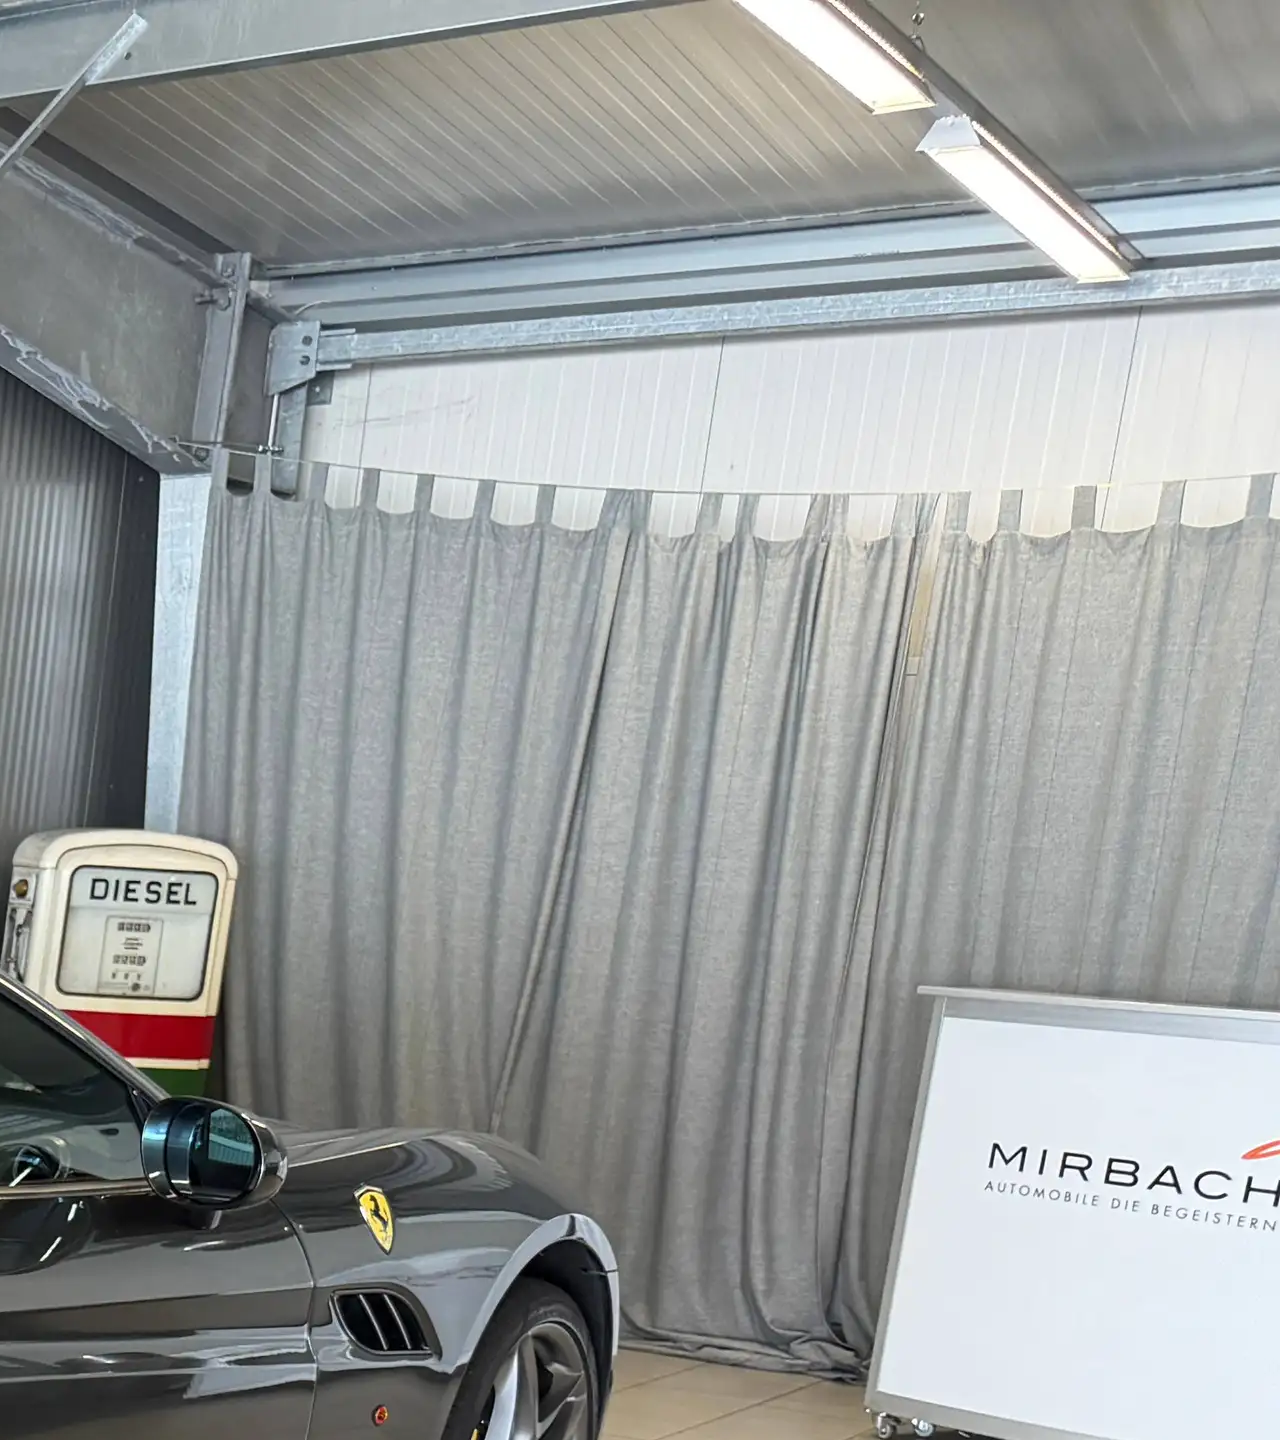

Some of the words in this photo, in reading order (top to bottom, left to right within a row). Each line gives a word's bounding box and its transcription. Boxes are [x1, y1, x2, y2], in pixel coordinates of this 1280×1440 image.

[89, 878, 198, 906] DIESEL
[988, 1142, 1280, 1208] MIRBACH
[984, 1180, 1100, 1207] AUTOMOBILE
[1110, 1197, 1140, 1213] DIE
[1150, 1203, 1278, 1232] BEGEISTERN
